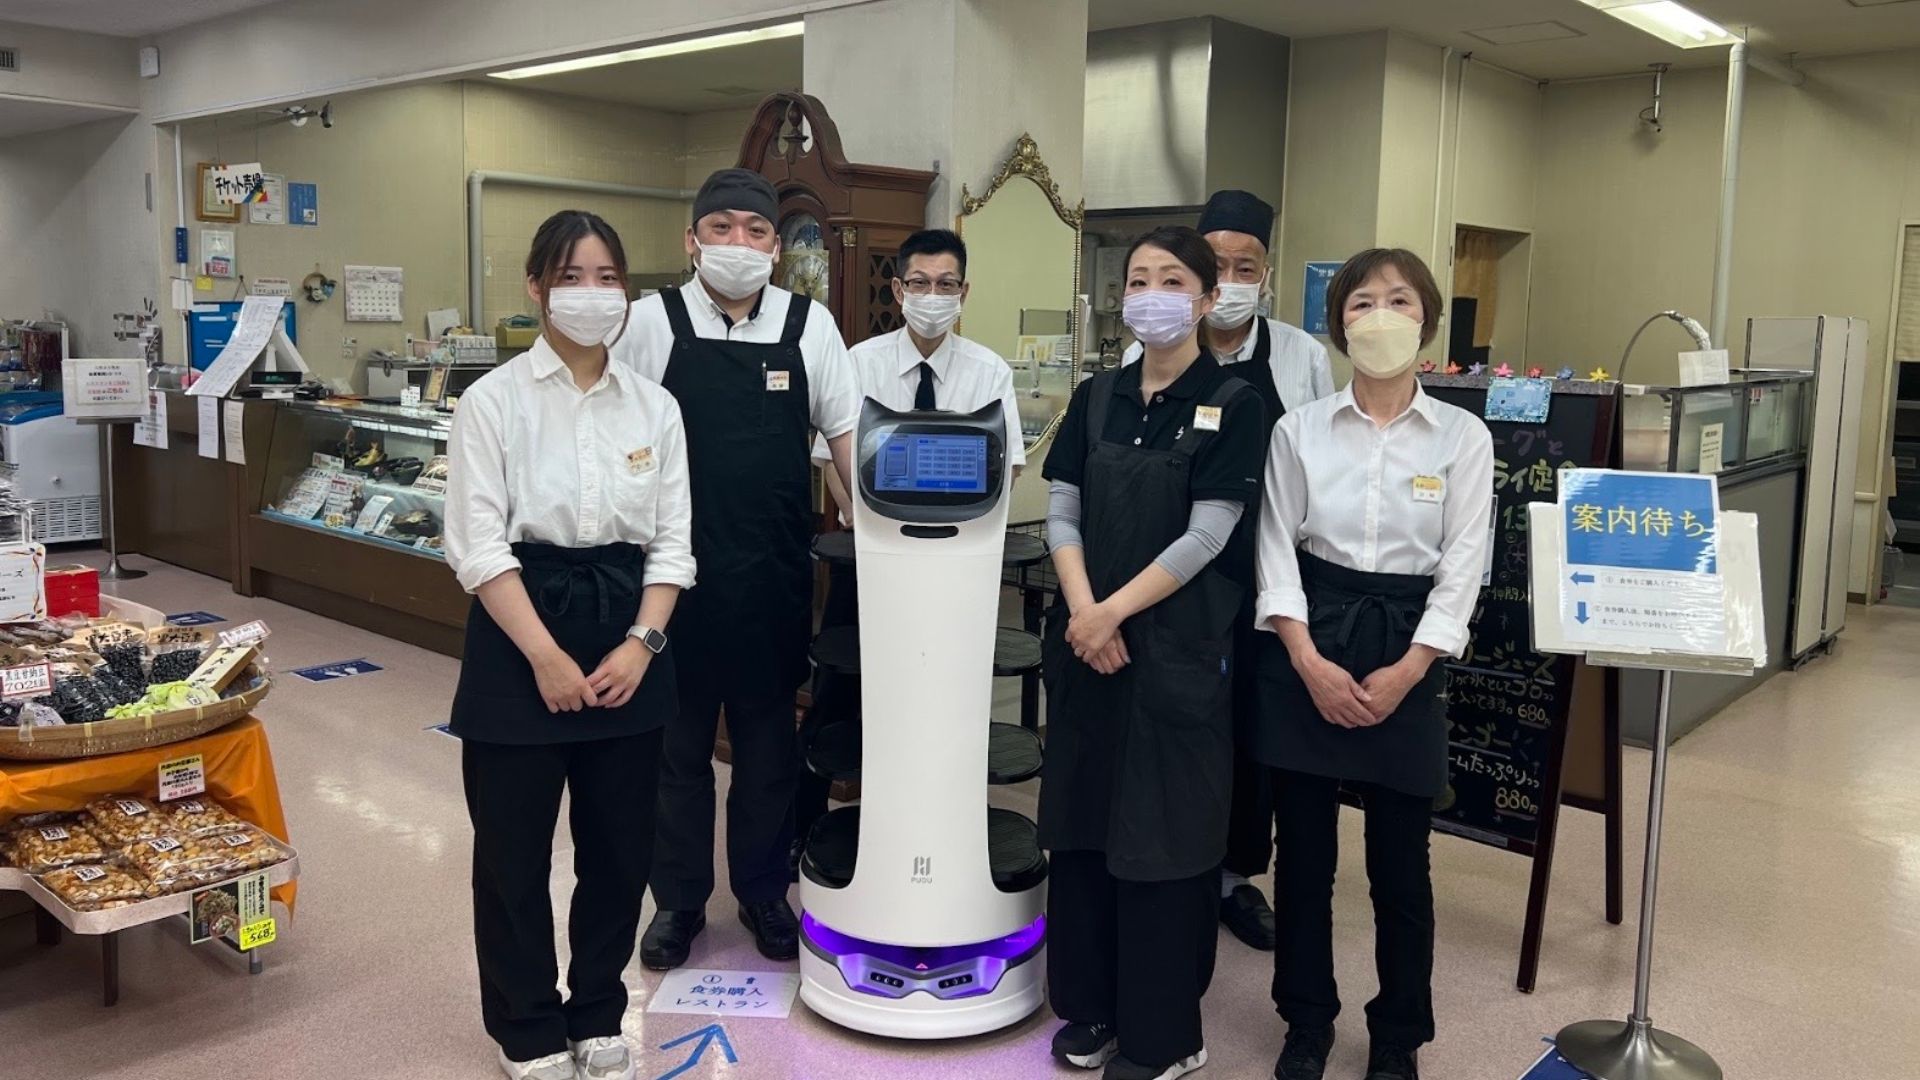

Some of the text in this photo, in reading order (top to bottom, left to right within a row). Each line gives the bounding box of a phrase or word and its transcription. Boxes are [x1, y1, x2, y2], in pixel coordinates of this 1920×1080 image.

[1494, 458, 1577, 493] ライ定
[1571, 503, 1706, 538] 案内待ち
[689, 984, 764, 997] 食券購入
[675, 998, 769, 1010] レストラン
